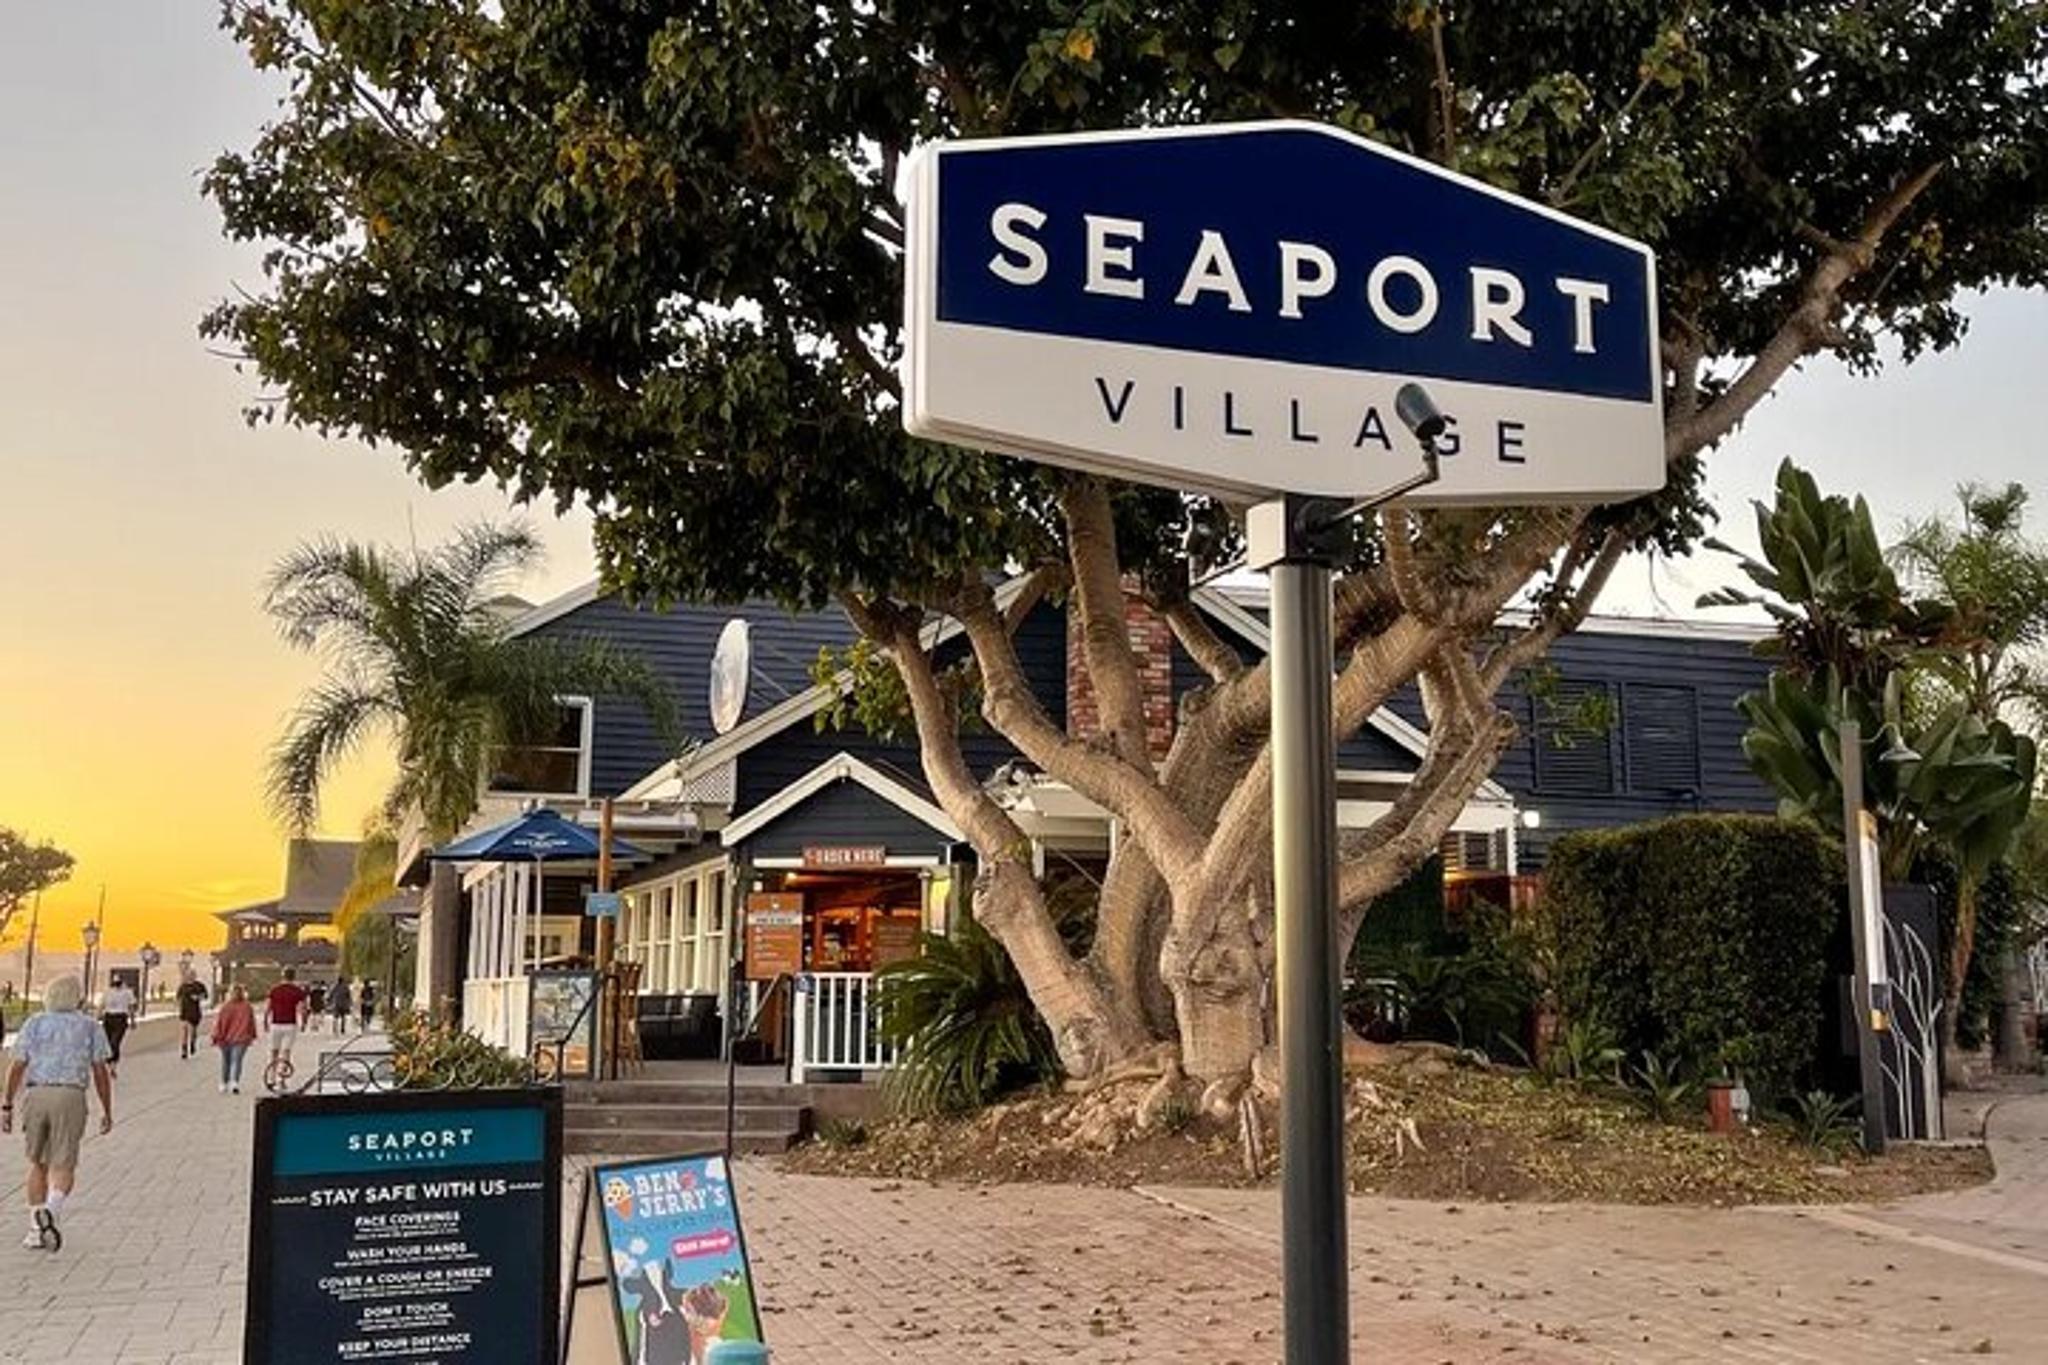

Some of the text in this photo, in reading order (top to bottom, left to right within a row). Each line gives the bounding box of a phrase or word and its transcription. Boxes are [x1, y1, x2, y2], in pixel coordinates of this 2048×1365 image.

[989, 203, 1609, 354] SEAPORT
[1095, 377, 1526, 464] VILLAGE
[348, 1128, 473, 1150] SEAPORT
[376, 1149, 446, 1161] VILLAGE
[310, 1179, 507, 1206] STAY SAFE WITH US
[634, 1170, 681, 1195] BEN
[639, 1184, 727, 1218] JERRY'S
[355, 1210, 460, 1227] FACE COVERINGS
[347, 1248, 385, 1260] WASH
[387, 1245, 421, 1257] YOUR
[423, 1242, 467, 1253] HANDS
[318, 1276, 362, 1289] COVER
[365, 1275, 374, 1284] A
[377, 1271, 421, 1284] COUGH
[423, 1270, 442, 1280] OR
[446, 1266, 493, 1278] SNEEZE
[363, 1302, 448, 1318] DON'T TOUCH
[338, 1341, 371, 1353] KEEP
[375, 1338, 408, 1349] YOUR
[411, 1333, 471, 1346] DISTANCE
